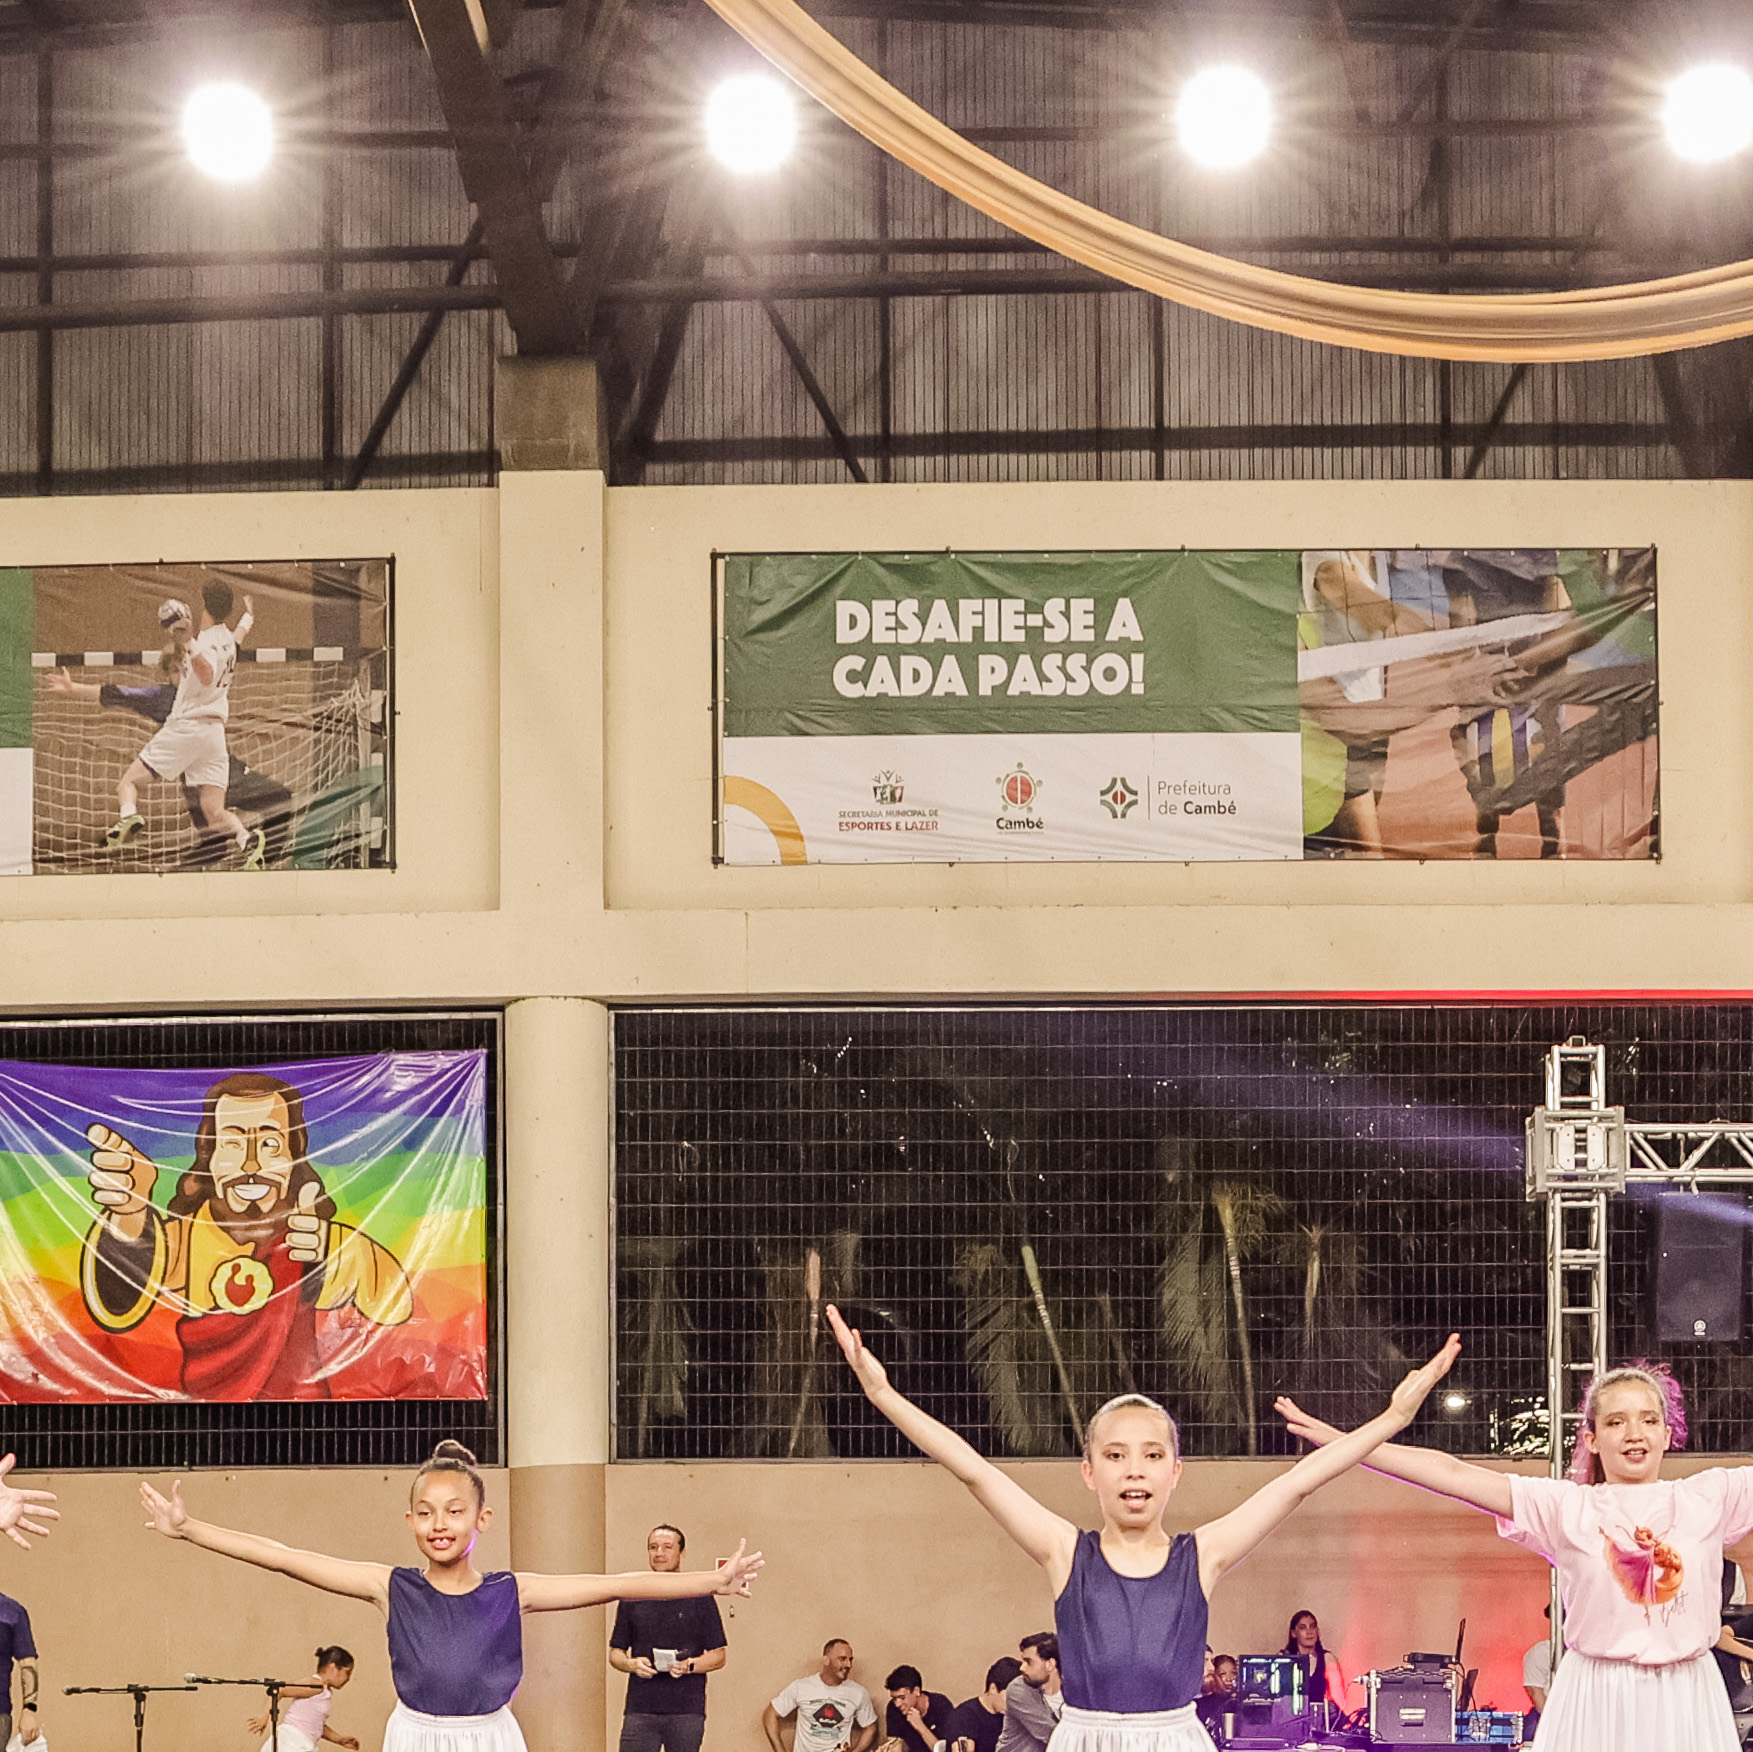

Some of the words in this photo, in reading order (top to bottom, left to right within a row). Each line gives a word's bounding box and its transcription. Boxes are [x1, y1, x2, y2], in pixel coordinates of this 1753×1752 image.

[835, 598, 1096, 644] DESAFIE-SE
[1104, 598, 1144, 641] A
[833, 654, 969, 698] CADA
[978, 652, 1145, 696] PASSO!
[1157, 779, 1232, 795] Prefeitura
[1158, 800, 1178, 815] de
[1183, 800, 1237, 815] Cambé
[838, 821, 892, 831] ESPORTES
[895, 821, 902, 831] E
[905, 820, 939, 831] LAZER
[996, 816, 1044, 830] Cambé
